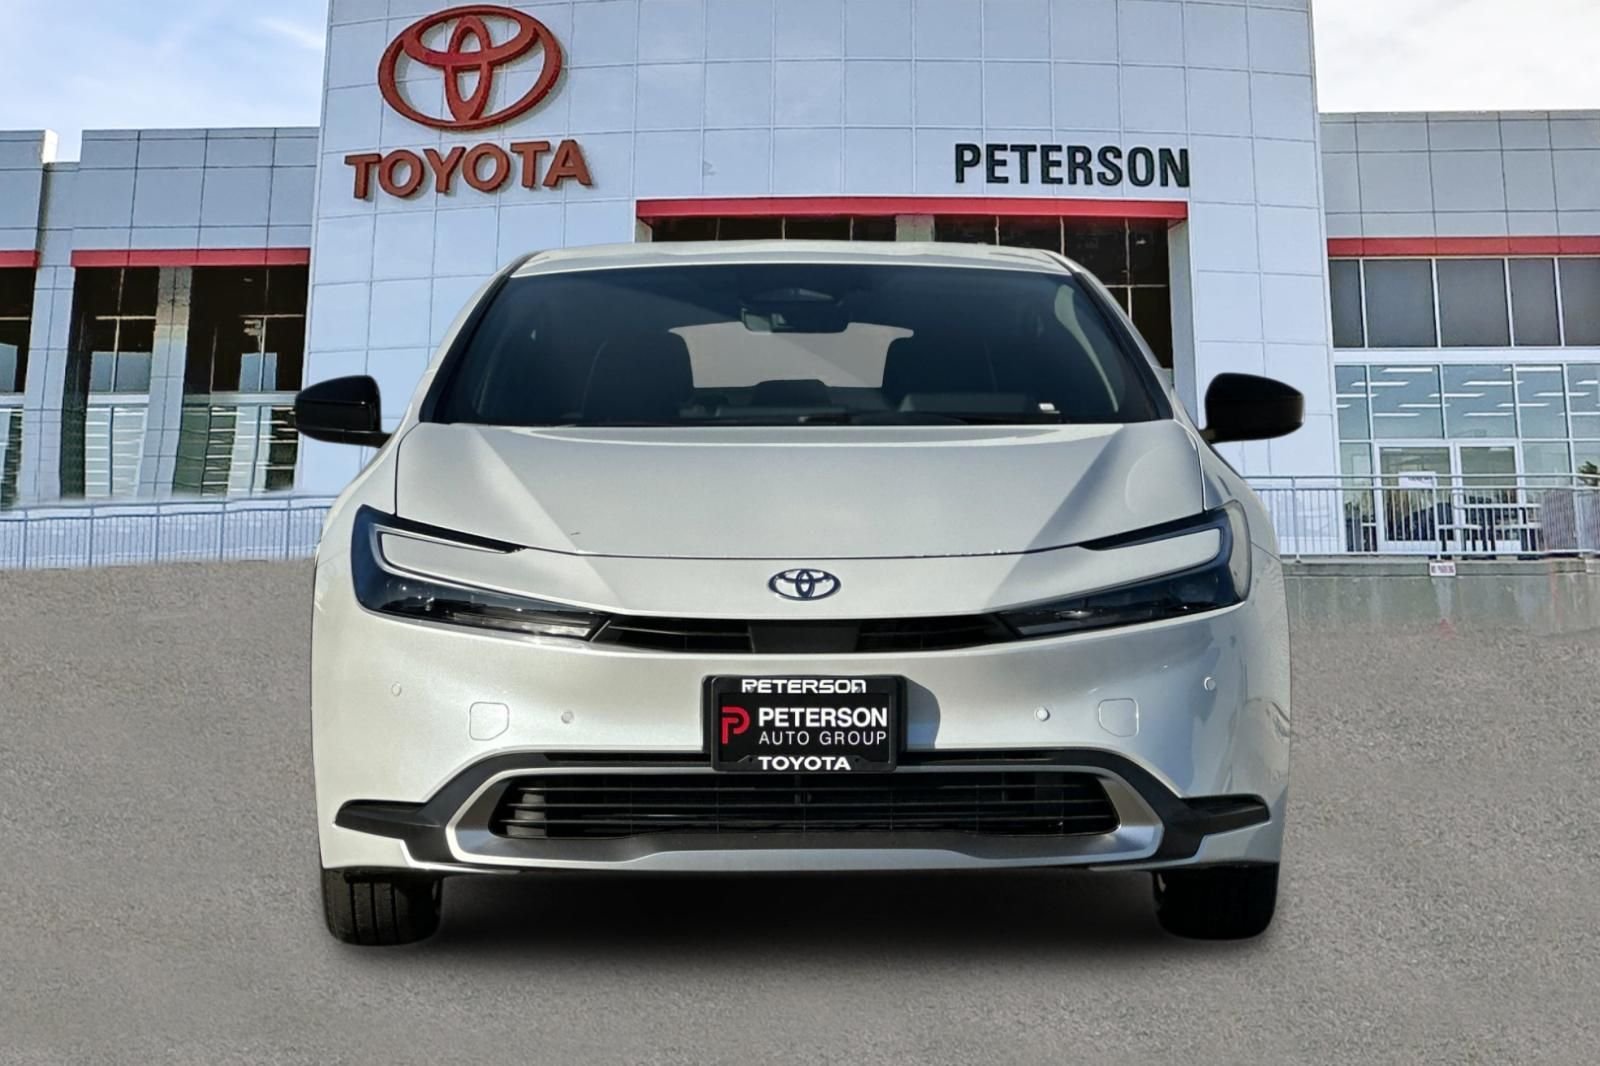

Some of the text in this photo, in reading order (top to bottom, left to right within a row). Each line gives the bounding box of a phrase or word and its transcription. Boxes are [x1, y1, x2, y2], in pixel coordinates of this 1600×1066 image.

[345, 140, 592, 199] TOYOTA
[955, 143, 1190, 188] PETERSON
[741, 679, 867, 694] PETERSON
[758, 707, 888, 728] PETERSON
[758, 731, 887, 745] AUTO GROUP
[758, 756, 851, 771] TOYOTA
